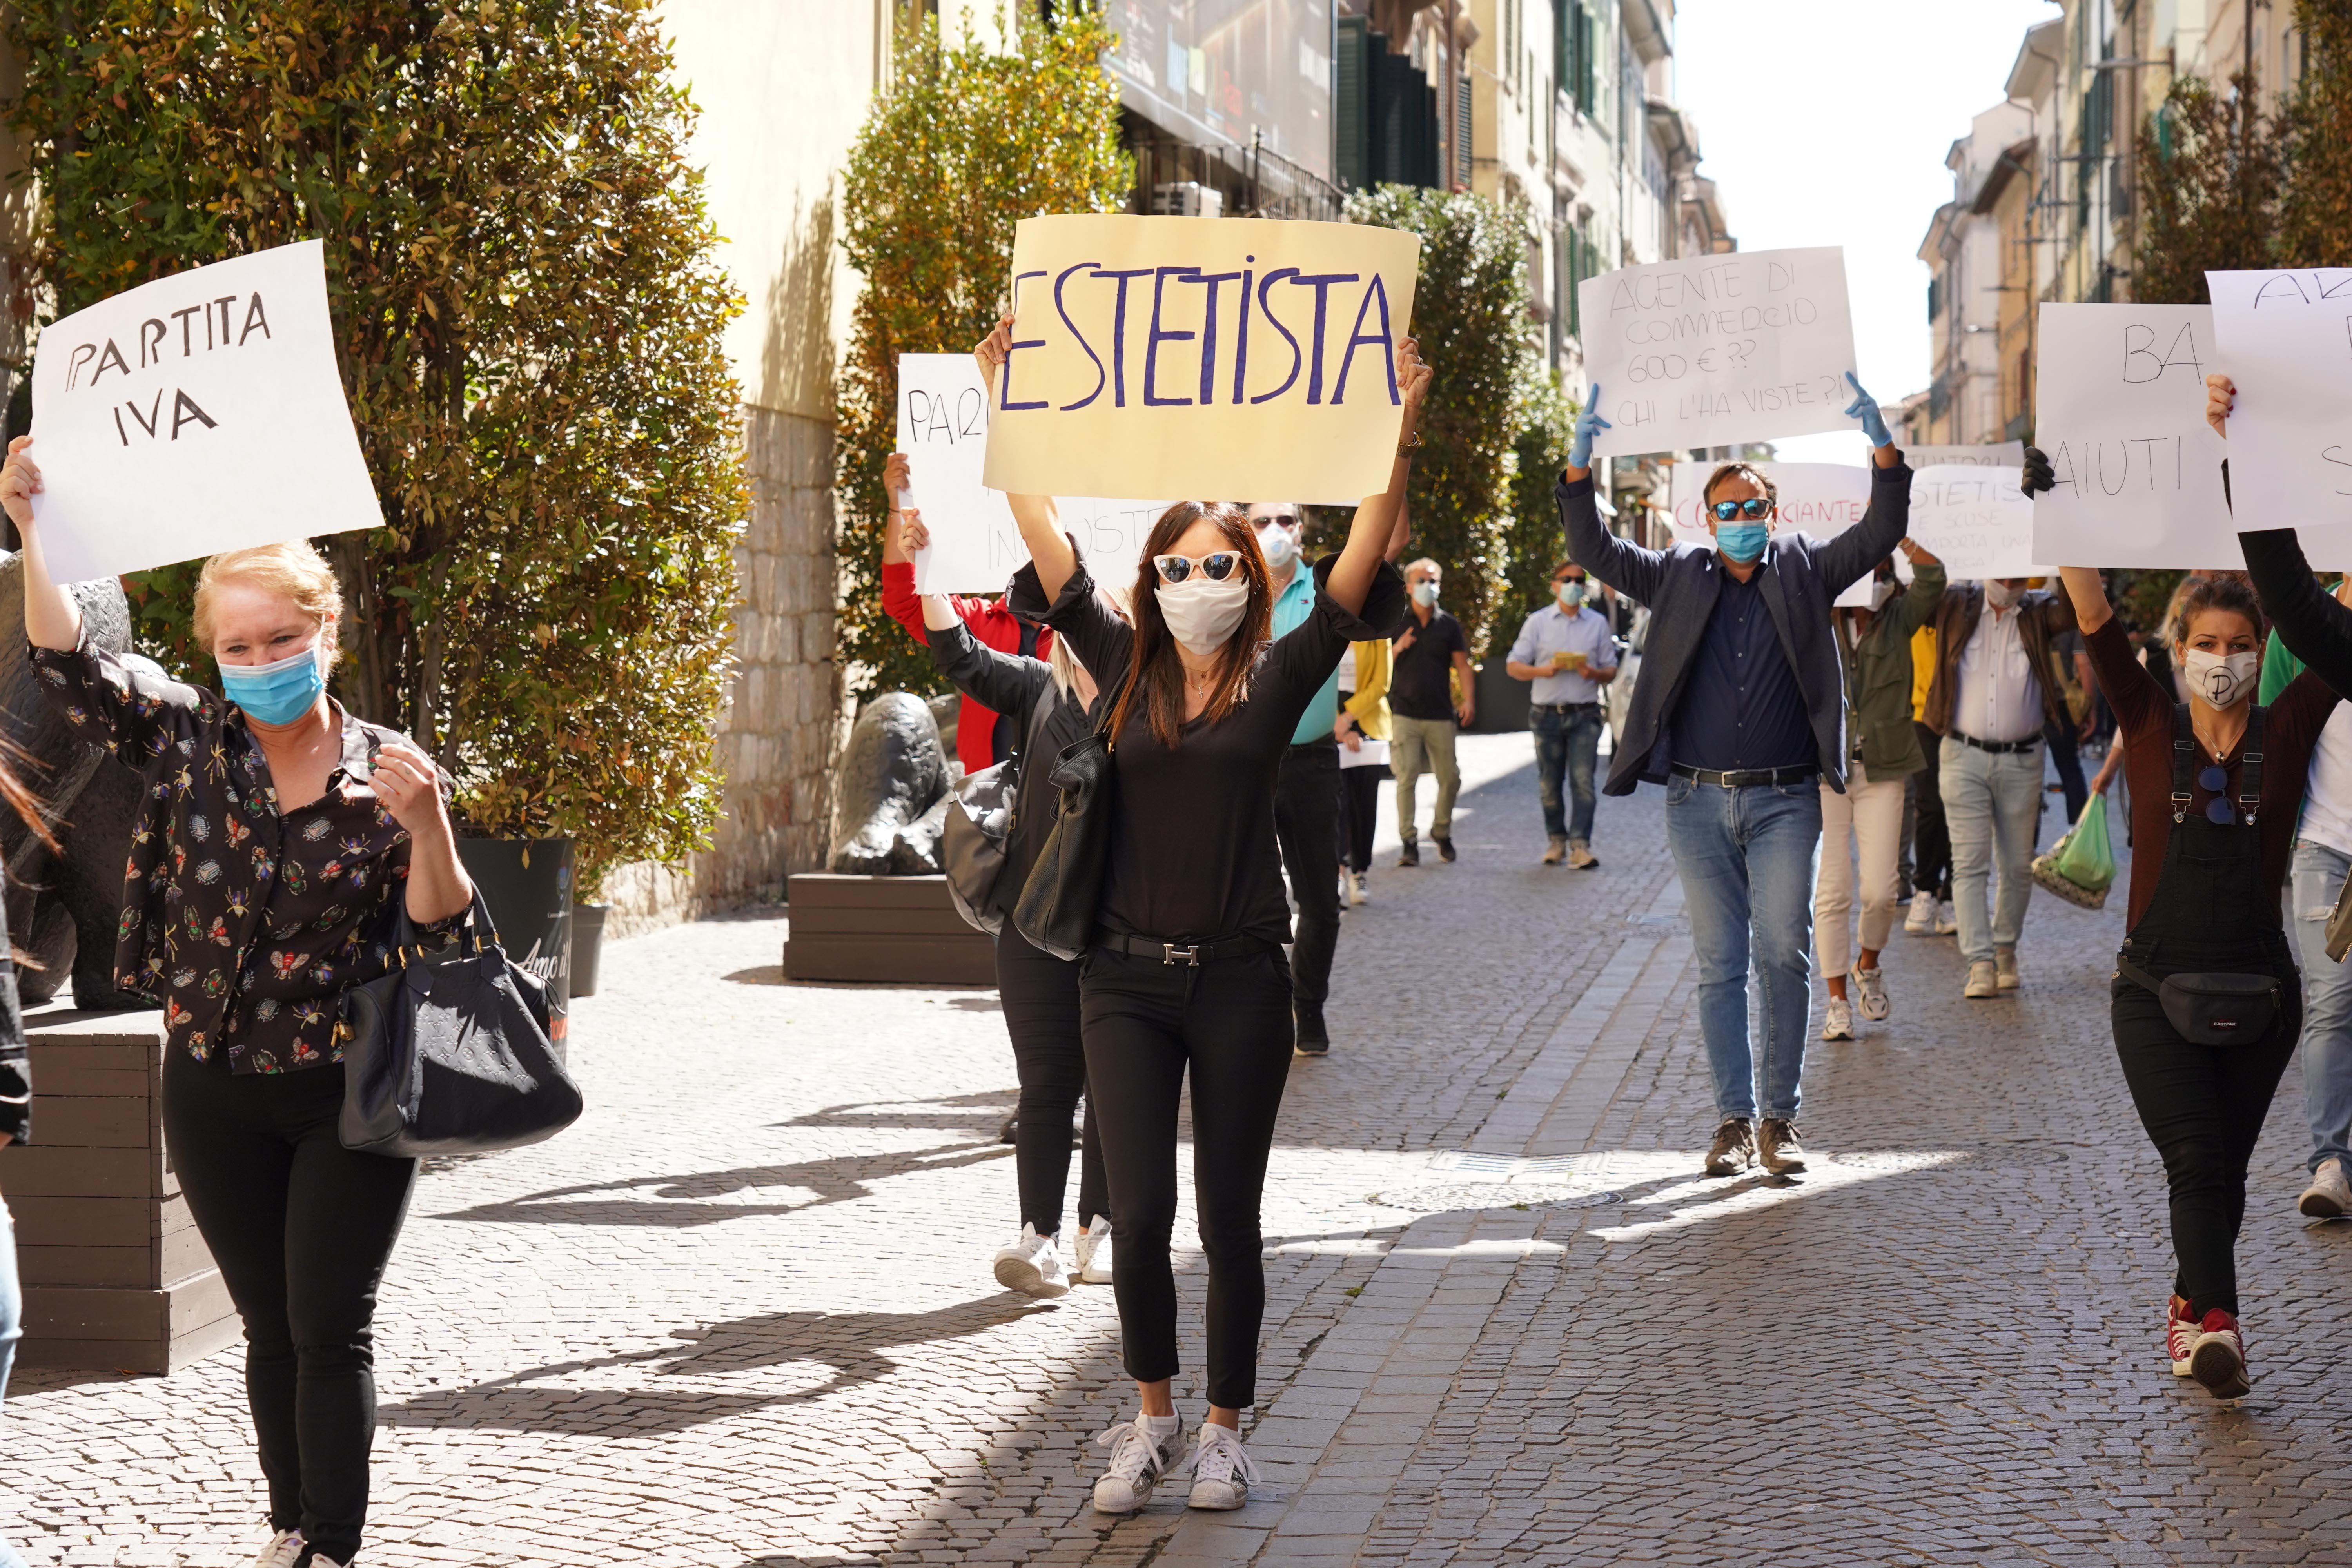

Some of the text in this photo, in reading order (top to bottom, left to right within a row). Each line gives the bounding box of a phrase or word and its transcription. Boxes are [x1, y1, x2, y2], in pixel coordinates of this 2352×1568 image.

[1610, 262, 1795, 318] AGENTE DI
[65, 291, 271, 392] PARTITA
[1625, 297, 1818, 345] COMMERCIO
[1627, 339, 1757, 383] 600 € ??
[113, 388, 220, 446] IVA
[1617, 400, 1657, 428] CHI
[1679, 392, 1731, 421] L'HA
[1742, 383, 1815, 413] VISTE
[2048, 436, 2180, 499] AIUTI
[1944, 508, 2005, 530] SCUSE
